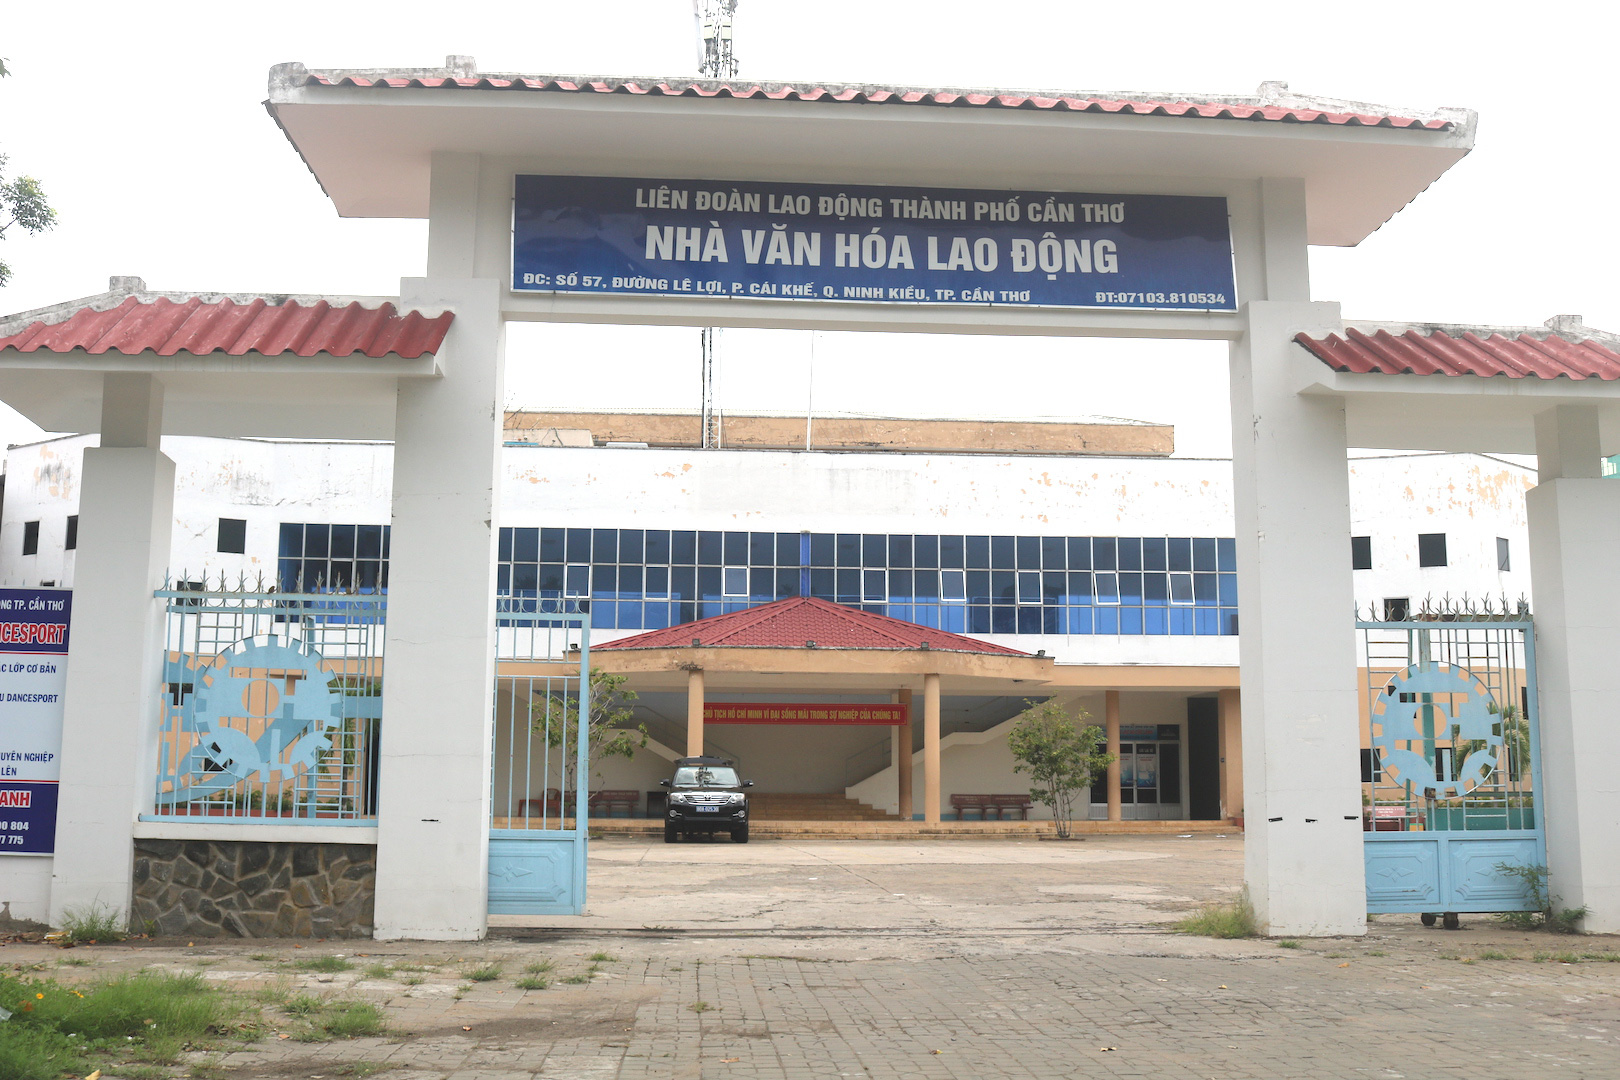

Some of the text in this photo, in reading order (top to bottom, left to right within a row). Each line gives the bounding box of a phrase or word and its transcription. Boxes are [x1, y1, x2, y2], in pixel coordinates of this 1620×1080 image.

[636, 185, 1125, 224] LIÊN ĐOÀN LAO ĐỘNG THÀNH PHỐ CẦN THƠ
[645, 221, 1119, 281] NHÀ VĂN HÓA LAO ĐỘNG
[523, 271, 1031, 303] ĐC: SỐ 57, ĐƯỜNG LÊ LỢI, P. CÁI KHẾ, Q. NINH KIỀU, TP. CẦN THƠ
[1095, 291, 1226, 304] ĐT:07103.810534
[14, 599, 27, 610] TP.
[47, 599, 65, 611] THƠ
[26, 663, 38, 673] CƠ
[6, 693, 59, 703] DANCESPORT
[747, 709, 762, 719] MINH
[23, 751, 54, 764] NGHIỆP
[1, 764, 17, 776] LÊN
[10, 821, 29, 831] 804
[8, 835, 24, 845] 775
